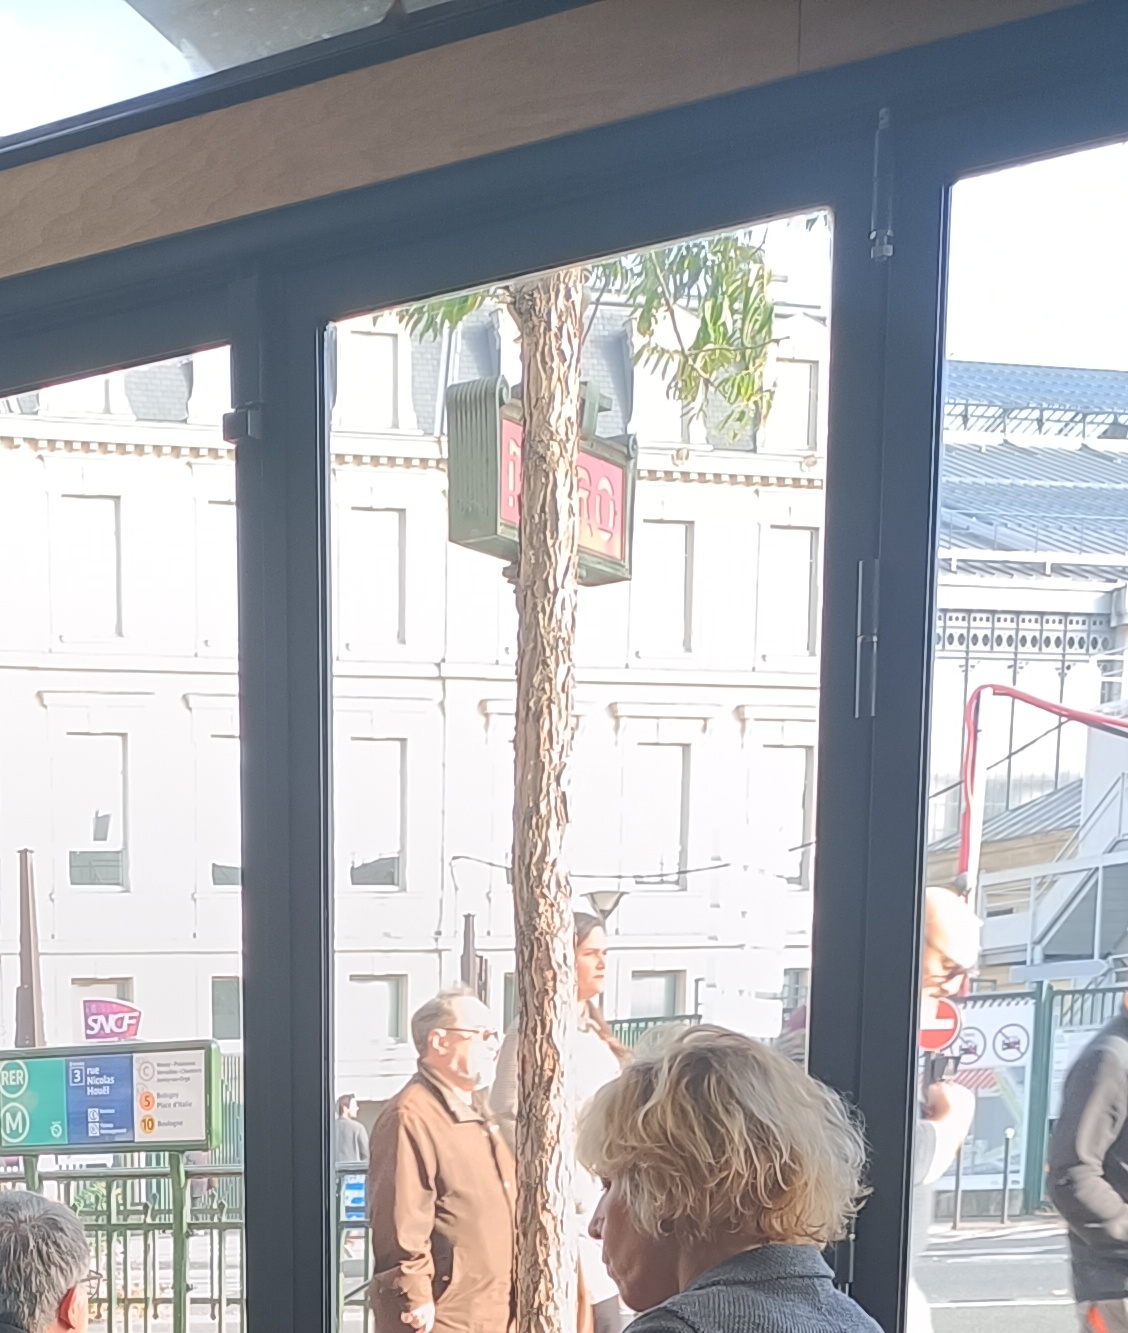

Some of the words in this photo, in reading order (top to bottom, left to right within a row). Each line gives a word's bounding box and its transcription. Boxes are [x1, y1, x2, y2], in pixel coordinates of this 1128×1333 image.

[86, 1012, 140, 1035] SNCF
[0, 1069, 24, 1087] RER
[73, 1069, 81, 1083] 3
[86, 1067, 100, 1075] rue
[86, 1075, 115, 1086] Nicolas
[5, 1110, 23, 1135] M
[141, 1118, 155, 1131] 10
